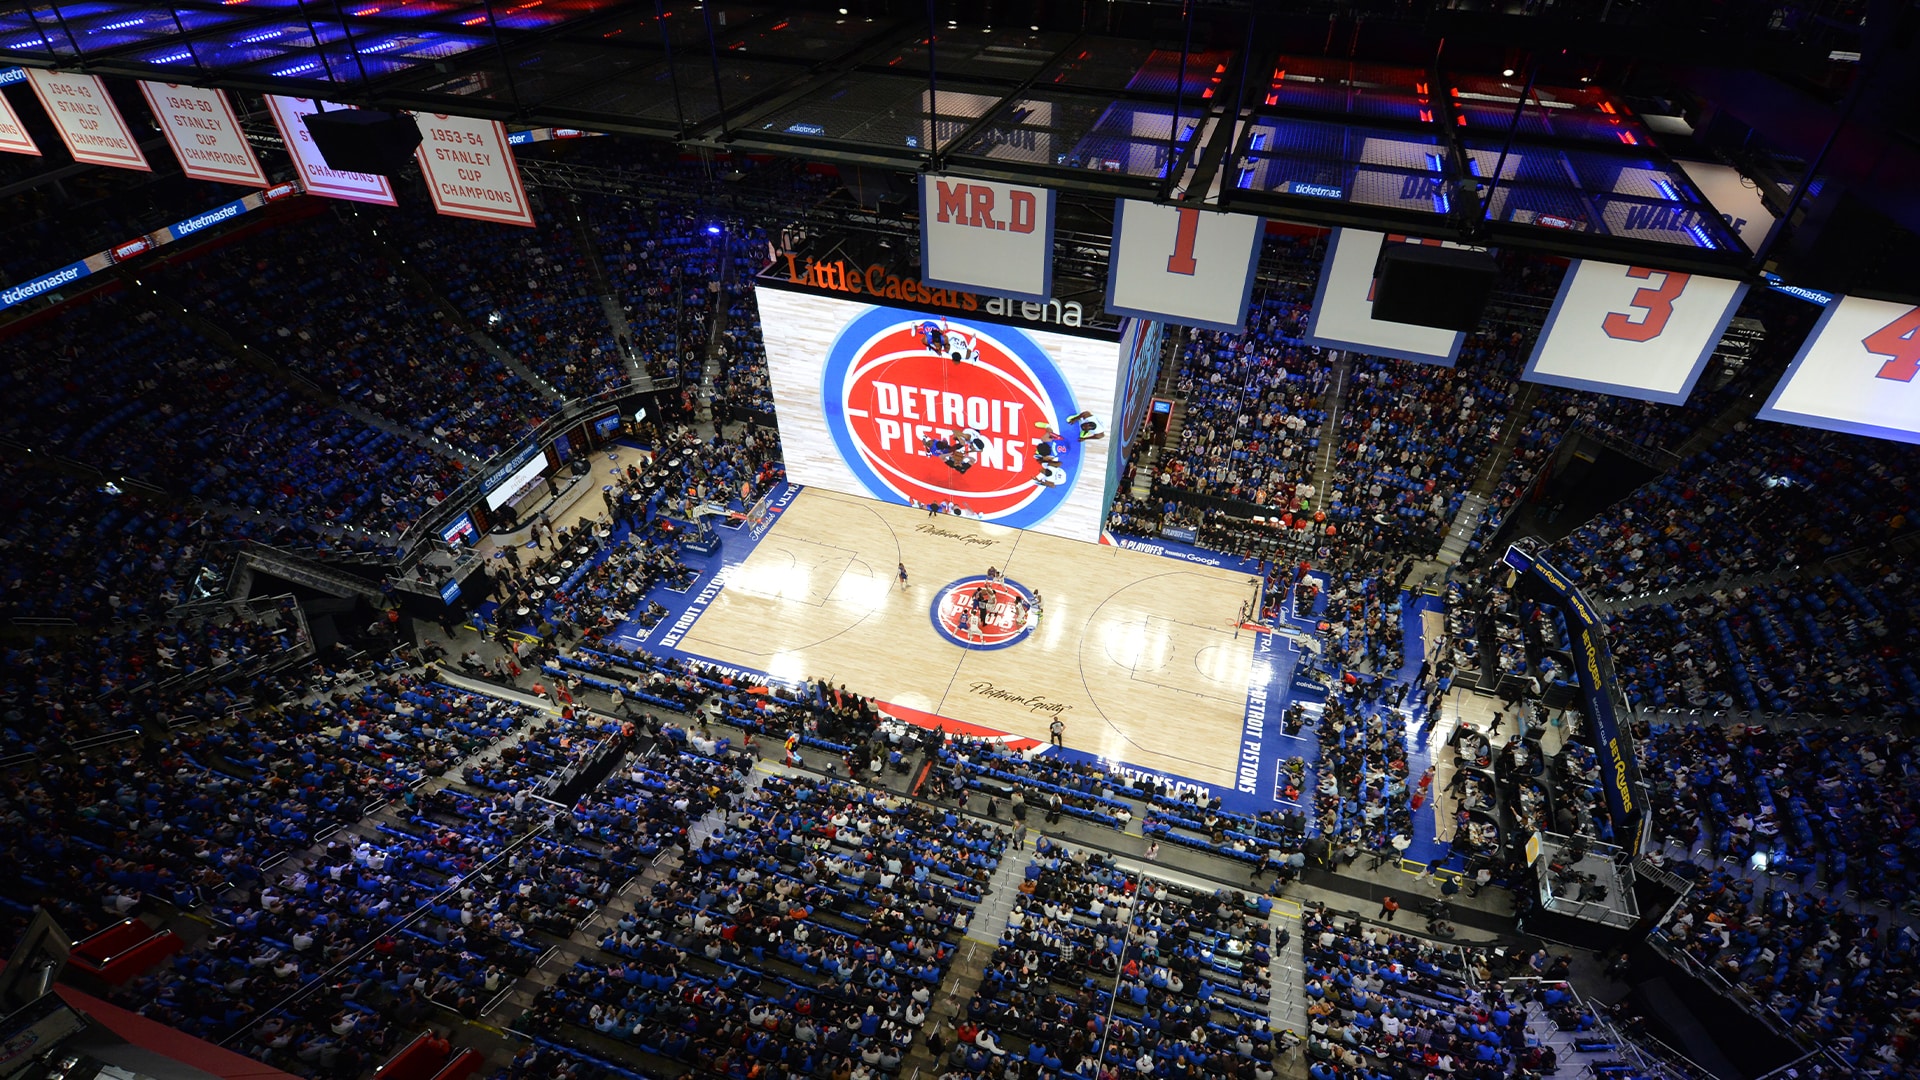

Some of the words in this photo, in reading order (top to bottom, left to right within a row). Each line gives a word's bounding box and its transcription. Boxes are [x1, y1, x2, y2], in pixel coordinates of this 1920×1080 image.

[48, 83, 91, 98] 1942-43
[58, 101, 102, 116] STANLEY
[166, 96, 212, 113] 1949-50
[79, 118, 99, 130] CUP
[174, 115, 223, 132] STANLEY
[71, 132, 128, 149] CHAMPIONS
[195, 133, 217, 146] CUP
[430, 128, 484, 147] 1953-54
[185, 147, 247, 166] CHAMPIONS
[435, 148, 491, 166] STANLEY
[457, 168, 482, 182] CUP
[441, 183, 513, 204] CHAMPIONS
[936, 180, 1036, 234] MR.D
[177, 204, 238, 236] ticketmaster
[1, 266, 79, 306] ticketmaster
[783, 252, 862, 293] Little
[864, 264, 978, 312] Caesars
[1601, 265, 1691, 343] 3
[872, 381, 1025, 437] DETROIT
[875, 417, 1025, 473] PISTNS
[1127, 540, 1165, 556] PLAYOFFS
[1187, 553, 1220, 566] Google
[658, 606, 702, 647] DETROIT
[1582, 628, 1602, 690] BETRIVERS
[1296, 681, 1325, 692] coinbase
[969, 681, 1025, 703] Platinum
[1024, 696, 1070, 717] Equity
[1238, 740, 1262, 795] PISTONS
[1609, 737, 1633, 814] BETRIVERS
